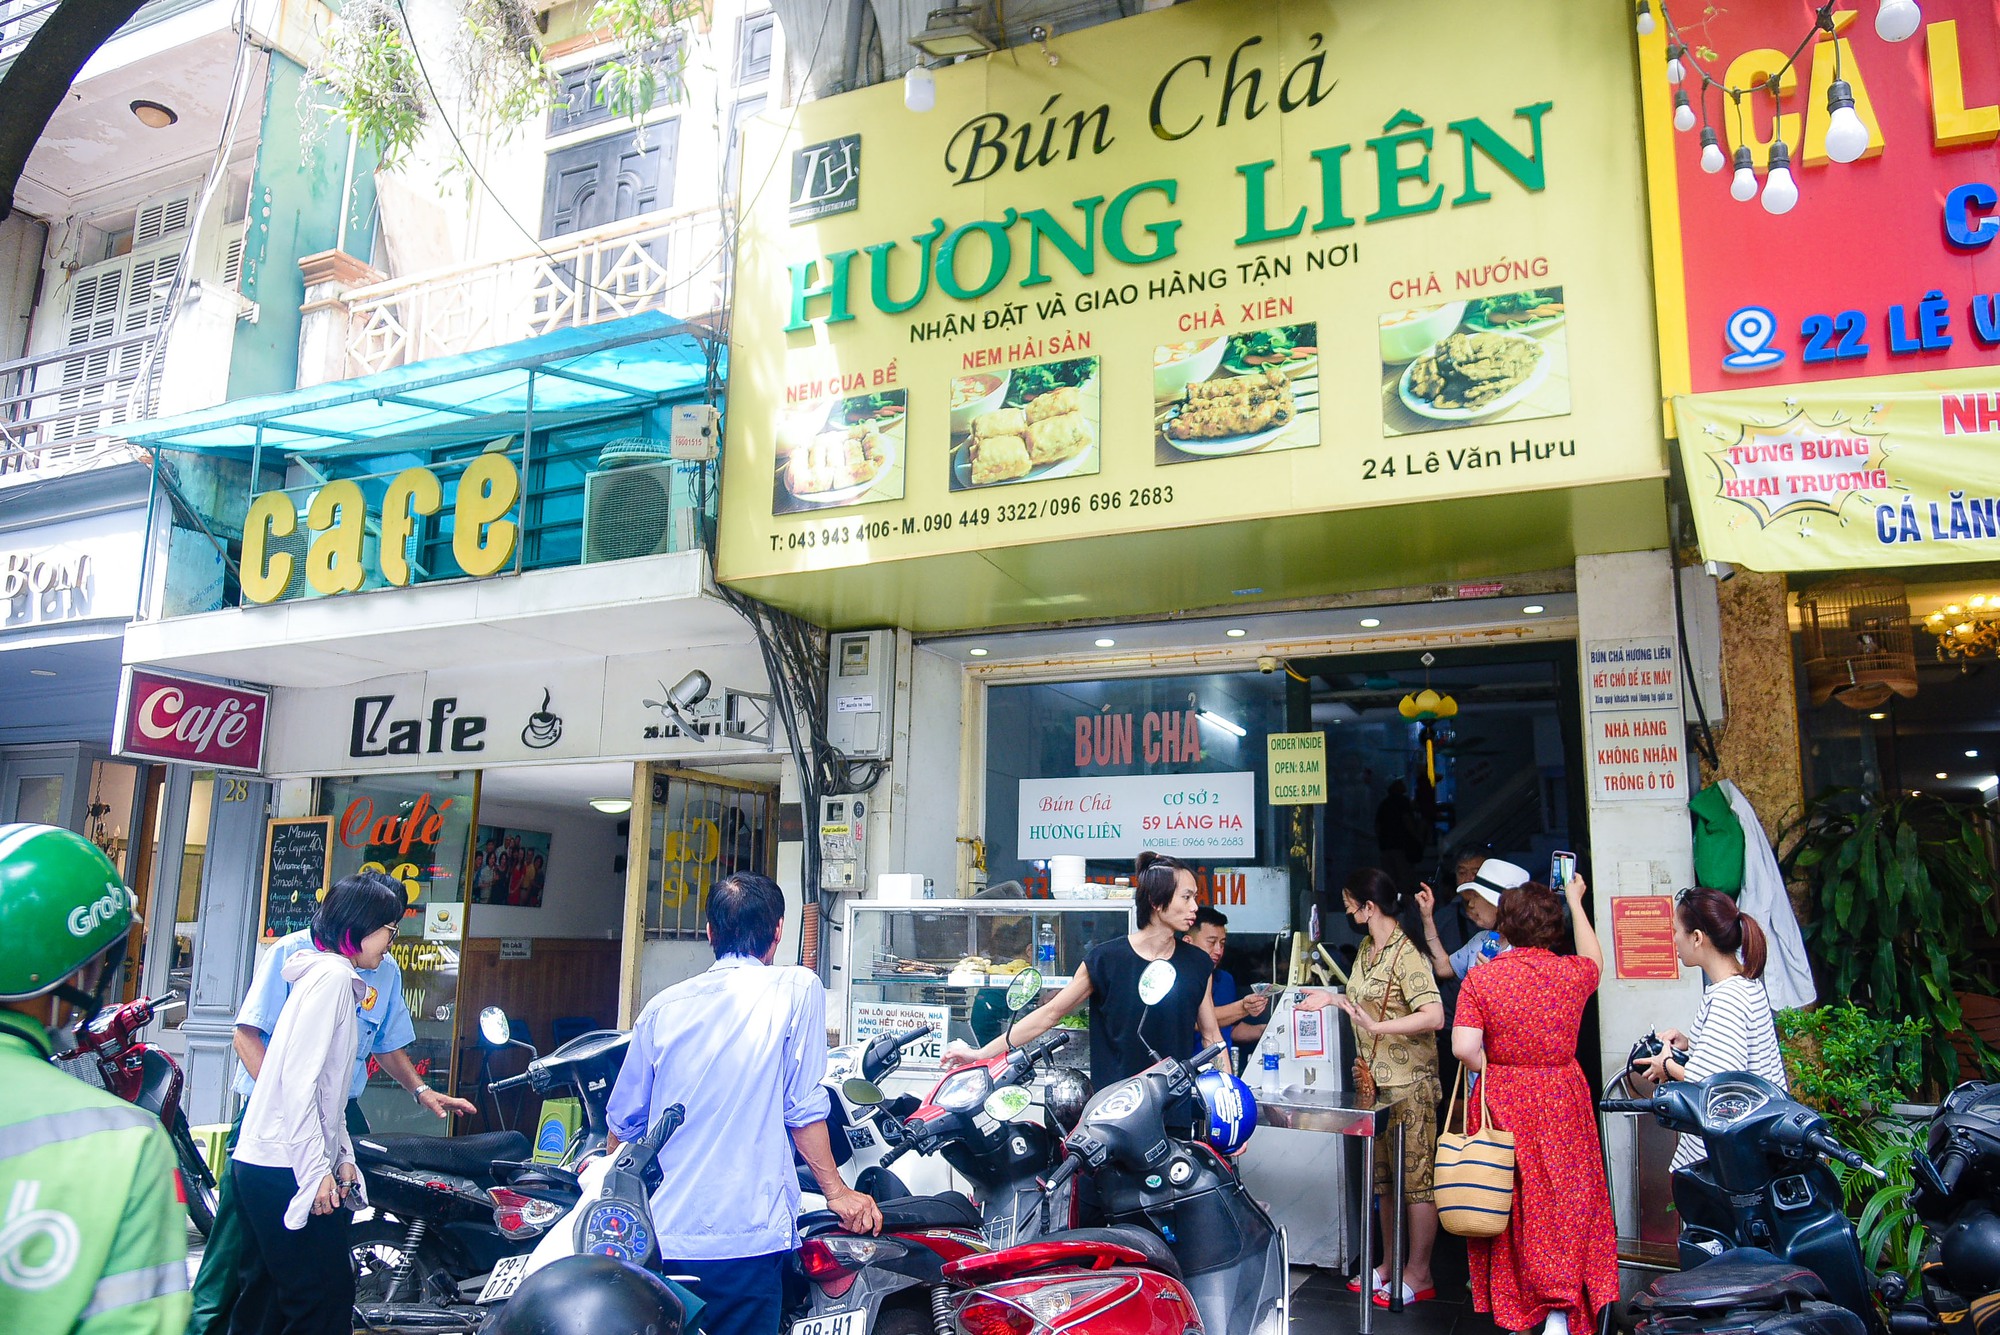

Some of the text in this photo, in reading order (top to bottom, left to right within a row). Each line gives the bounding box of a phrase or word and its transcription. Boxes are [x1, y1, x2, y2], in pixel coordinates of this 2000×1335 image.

[944, 31, 1339, 187] Bún Chả
[782, 101, 1555, 334] HƯƠNG LIÊN
[1388, 256, 1550, 301] CHẢ NƯỚNG
[910, 242, 1359, 344] NHẬN ĐẶT VÀ GIAO HÀNG TẬN NƠI
[1179, 295, 1294, 333] CHẢ XIÊN
[1800, 309, 1869, 364] 22
[1888, 290, 1953, 353] LÊ
[962, 331, 1092, 371] NEM HẢI SẢN
[787, 381, 823, 404] NEM
[829, 371, 867, 396] CUA
[1362, 437, 1577, 482] 24 Lê Văn Hưu
[1728, 434, 1869, 467] TƯNG BỪNG
[1725, 476, 1783, 500] KHAI
[770, 534, 784, 551] T:
[788, 530, 816, 550] 043
[821, 526, 849, 547] 943
[959, 507, 990, 528] 449
[1090, 490, 1122, 512] 696
[1130, 485, 1174, 508] 2683
[1875, 490, 2000, 546] CÁ LĂN
[1590, 648, 1607, 664] BÚN
[1625, 647, 1652, 662] HƯƠNG
[1654, 644, 1672, 660] LIÊN
[1593, 670, 1608, 688] HẾT
[1641, 671, 1652, 686] XE
[1653, 667, 1672, 685] MÁY
[138, 687, 257, 754] Café
[350, 694, 487, 758] Cafe
[1074, 692, 1201, 767] BÚN CHẢ
[1604, 718, 1668, 739] NHÀ HÀNG
[1271, 736, 1322, 750] ORDER INSIDE
[1598, 743, 1679, 766] KHÔNG NHẬN
[1274, 760, 1319, 774] OPEN: 8.AM
[222, 778, 250, 804] 28
[1274, 784, 1321, 798] CLOSE: 8.PM
[1604, 770, 1675, 791] TRÔNG Ô TÔ
[1039, 793, 1112, 813] Bún Chả
[1163, 788, 1219, 806] CƠ SỞ 2
[339, 792, 453, 854] Café
[1029, 820, 1122, 840] HƯƠNG LIÊN
[1142, 811, 1243, 832] 59 LÁNG HẠ
[1142, 837, 1244, 848] MOBILE: 0966 96 2683
[67, 882, 126, 938] Grab
[858, 1008, 870, 1016] XIN
[885, 1009, 898, 1017] QUÍ
[928, 1012, 943, 1020] NHÀ
[858, 1017, 877, 1026] HÀNG
[920, 1043, 941, 1059] XE
